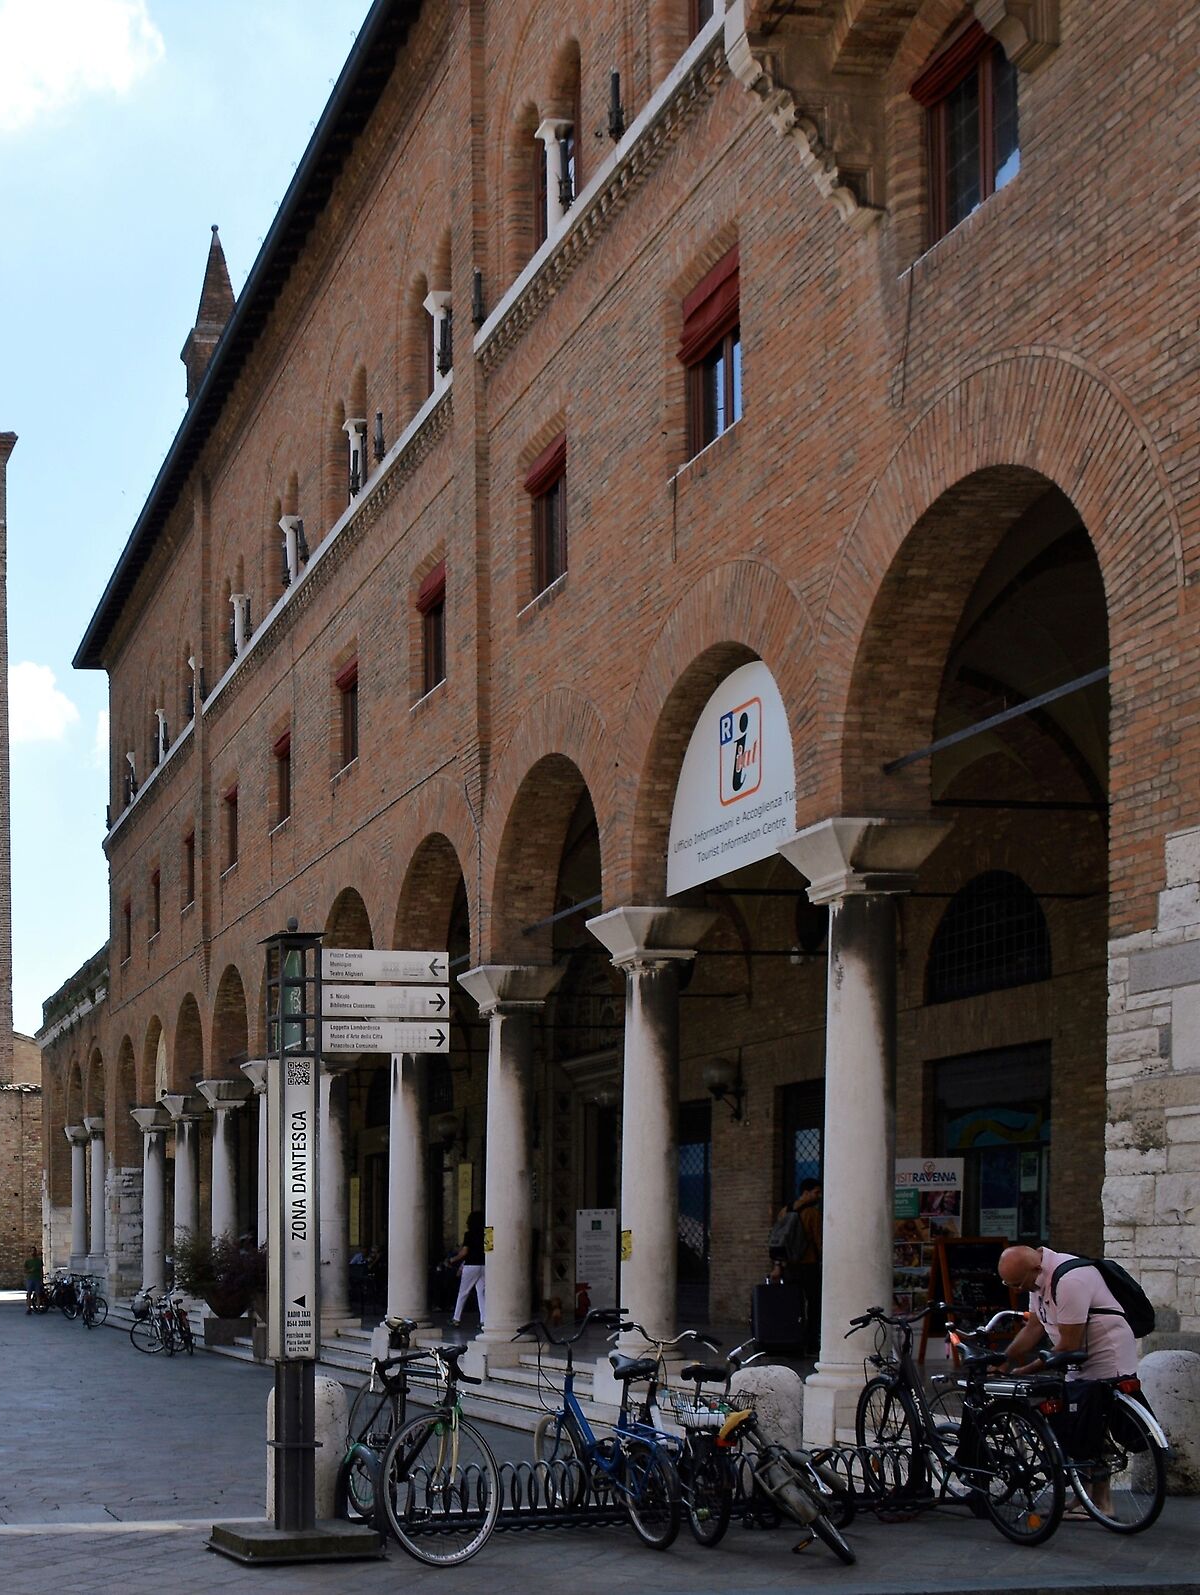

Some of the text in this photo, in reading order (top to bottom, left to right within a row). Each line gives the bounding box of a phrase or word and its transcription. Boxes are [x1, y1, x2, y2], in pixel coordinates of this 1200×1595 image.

[721, 717, 731, 742] R
[674, 837, 693, 853] Ufficio
[694, 818, 735, 844] Informazioni
[735, 816, 740, 825] e
[742, 797, 782, 821] Accoglienza
[697, 817, 786, 862] Tourist Information Centre
[291, 1110, 307, 1241] ZONA DANTESCA
